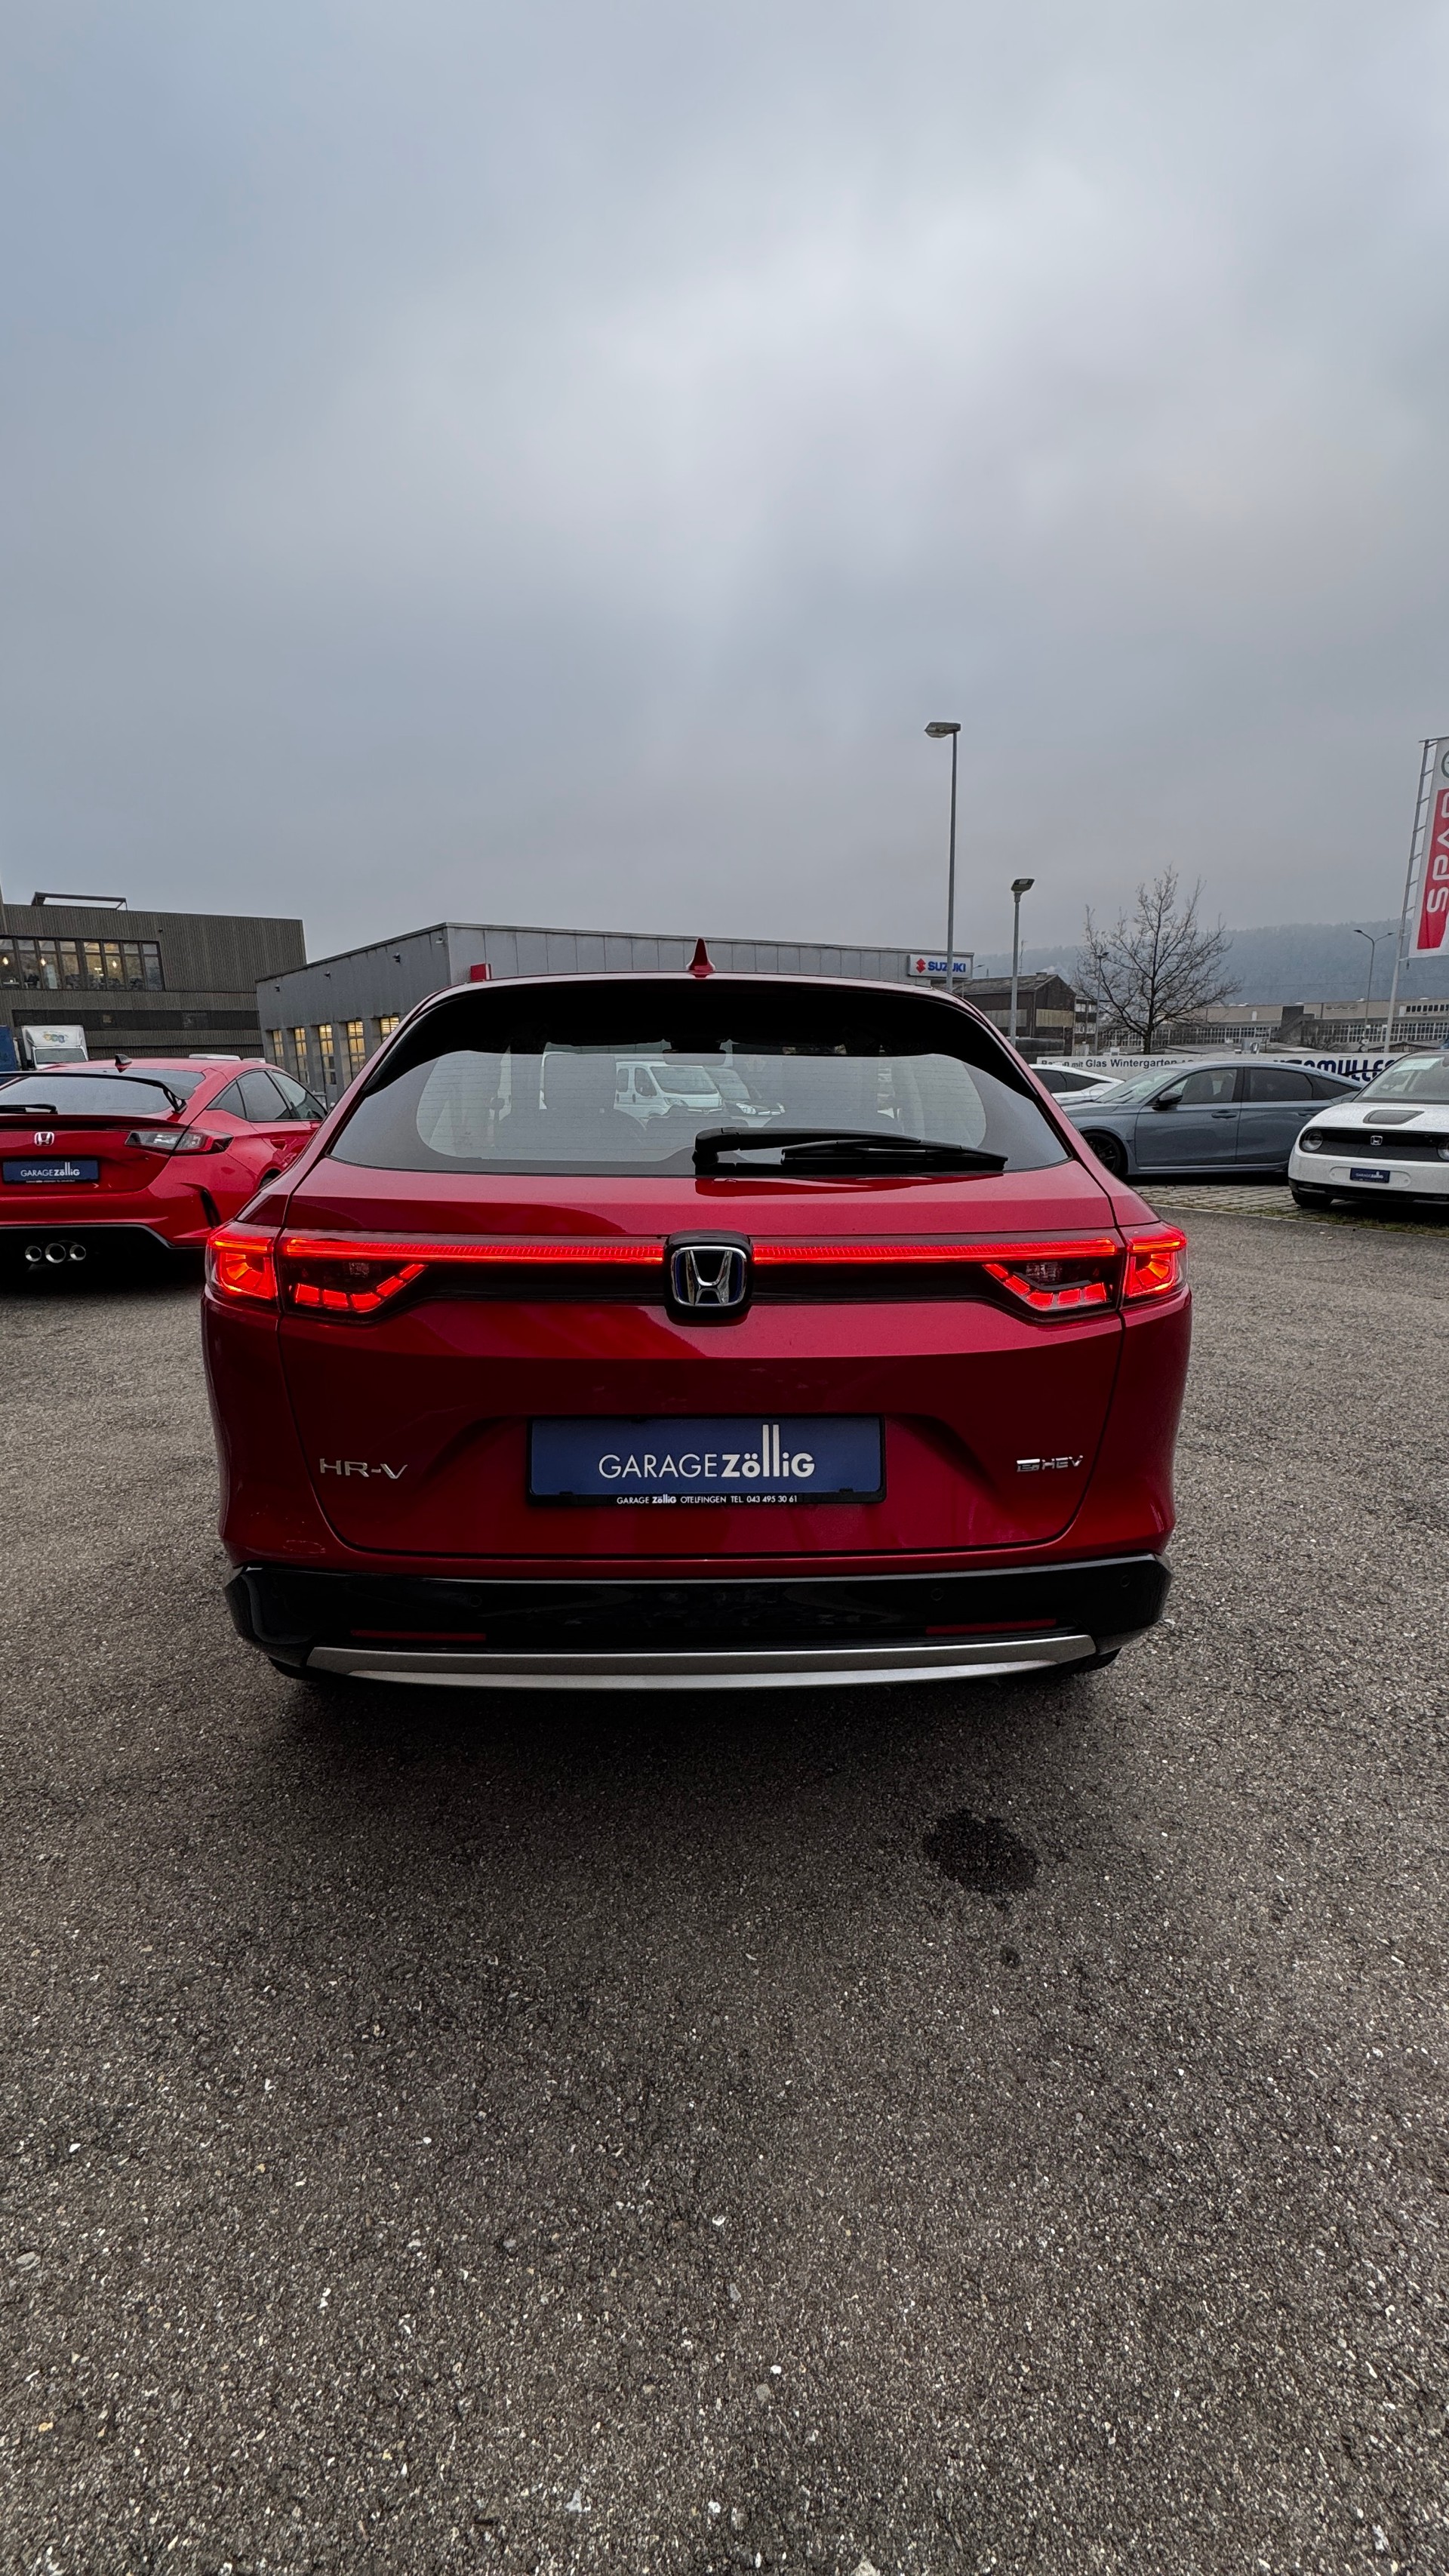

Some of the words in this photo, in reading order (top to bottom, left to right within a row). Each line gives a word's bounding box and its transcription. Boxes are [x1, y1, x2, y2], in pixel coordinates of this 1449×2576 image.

[1085, 1059, 1107, 1068] Glas
[1110, 1059, 1177, 1069] Wintergarten
[319, 1458, 408, 1479] HR-V
[617, 1496, 649, 1504] GARAGE
[681, 1495, 726, 1503] OTELFINGEN
[746, 1495, 760, 1503] 043
[762, 1495, 776, 1503] 495
